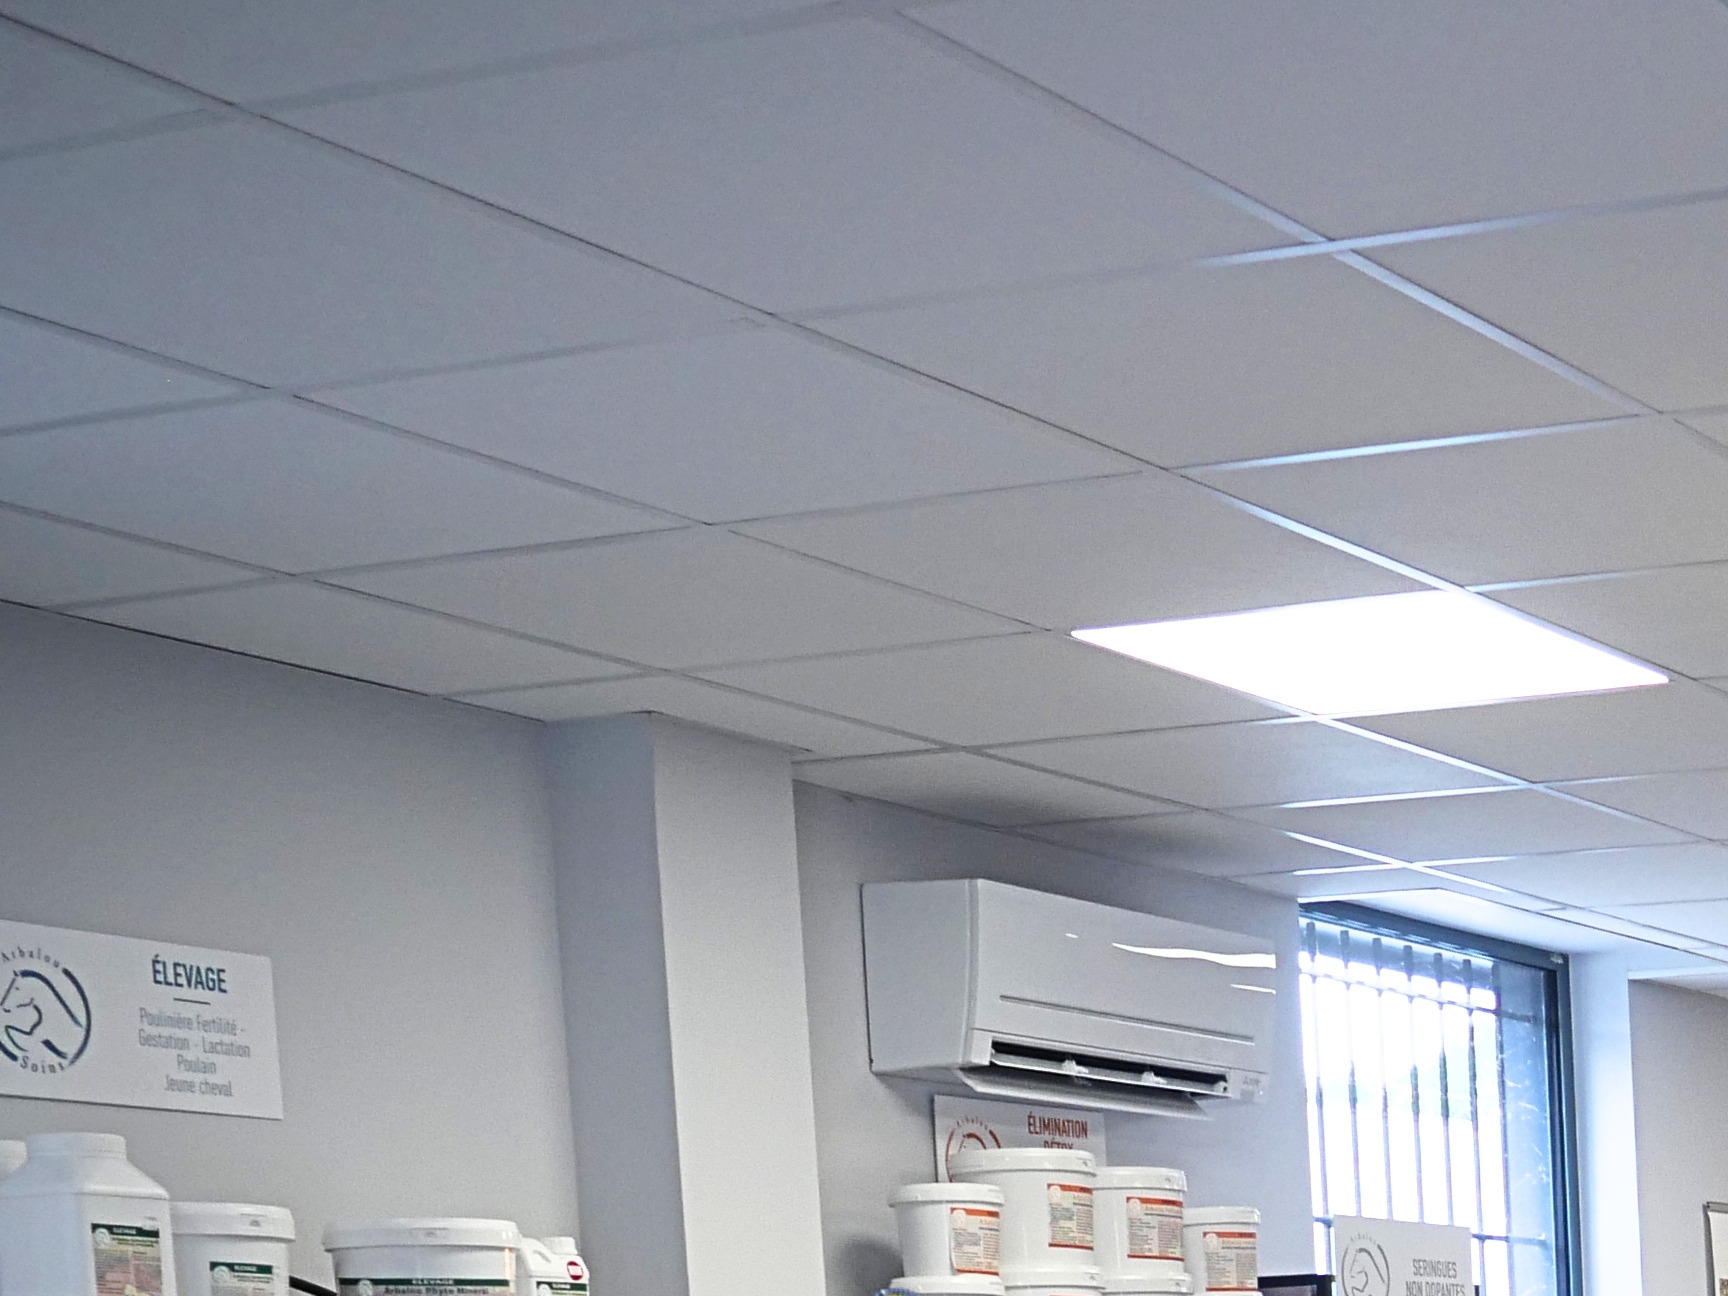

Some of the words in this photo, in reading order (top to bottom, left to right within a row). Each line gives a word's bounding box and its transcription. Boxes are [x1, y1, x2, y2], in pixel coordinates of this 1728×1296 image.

[151, 953, 228, 995] ÉLEVAGE
[1027, 1111, 1088, 1140] ÉLIMINATION
[1412, 1258, 1458, 1280] SERINGUES
